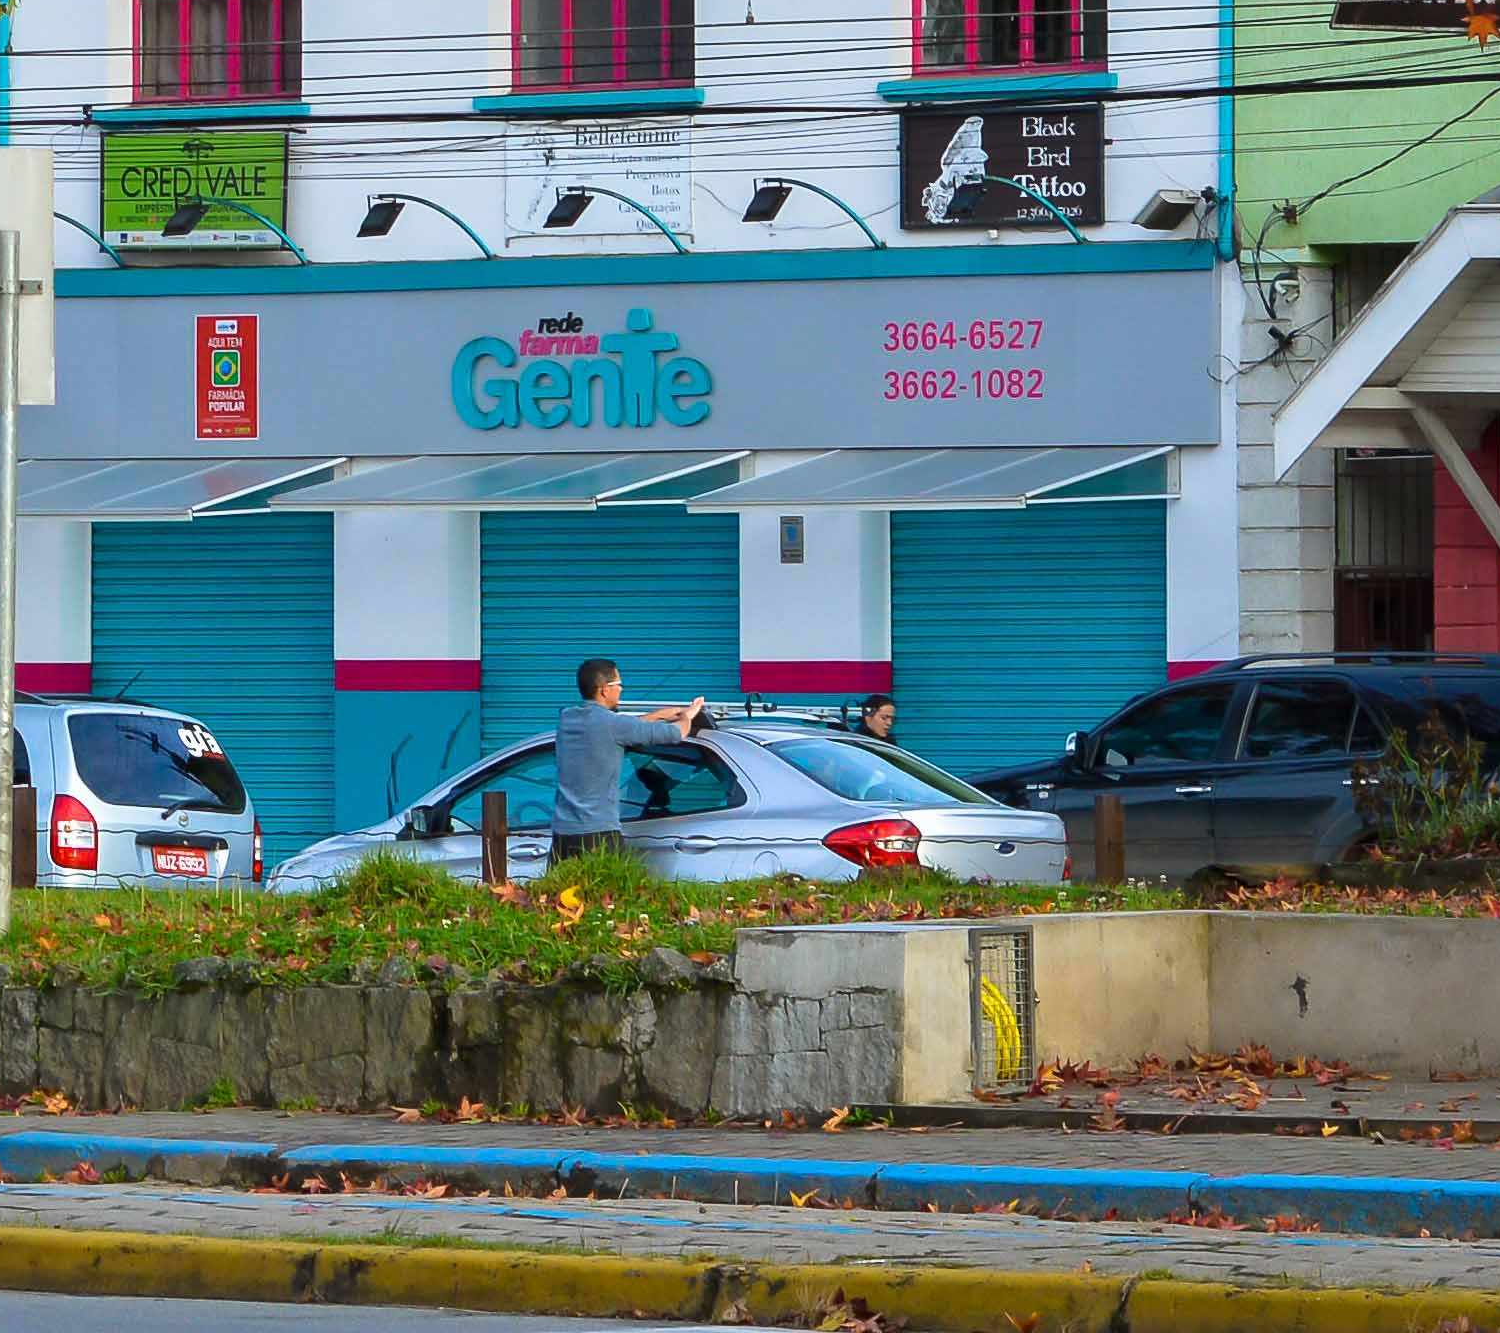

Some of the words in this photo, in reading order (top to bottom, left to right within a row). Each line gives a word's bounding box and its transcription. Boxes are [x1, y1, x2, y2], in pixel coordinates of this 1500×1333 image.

[1022, 115, 1076, 137] Black
[1027, 146, 1071, 167] Bird
[120, 165, 192, 198] CRED
[205, 165, 266, 197] VALE
[1012, 174, 1086, 198] Tattoo
[538, 312, 584, 334] rede
[518, 330, 600, 356] farma
[883, 320, 1044, 352] 3664-6527
[208, 389, 245, 401] FARMÁCIA
[883, 369, 1044, 400] 3662-1082
[208, 401, 245, 412] POPULAR
